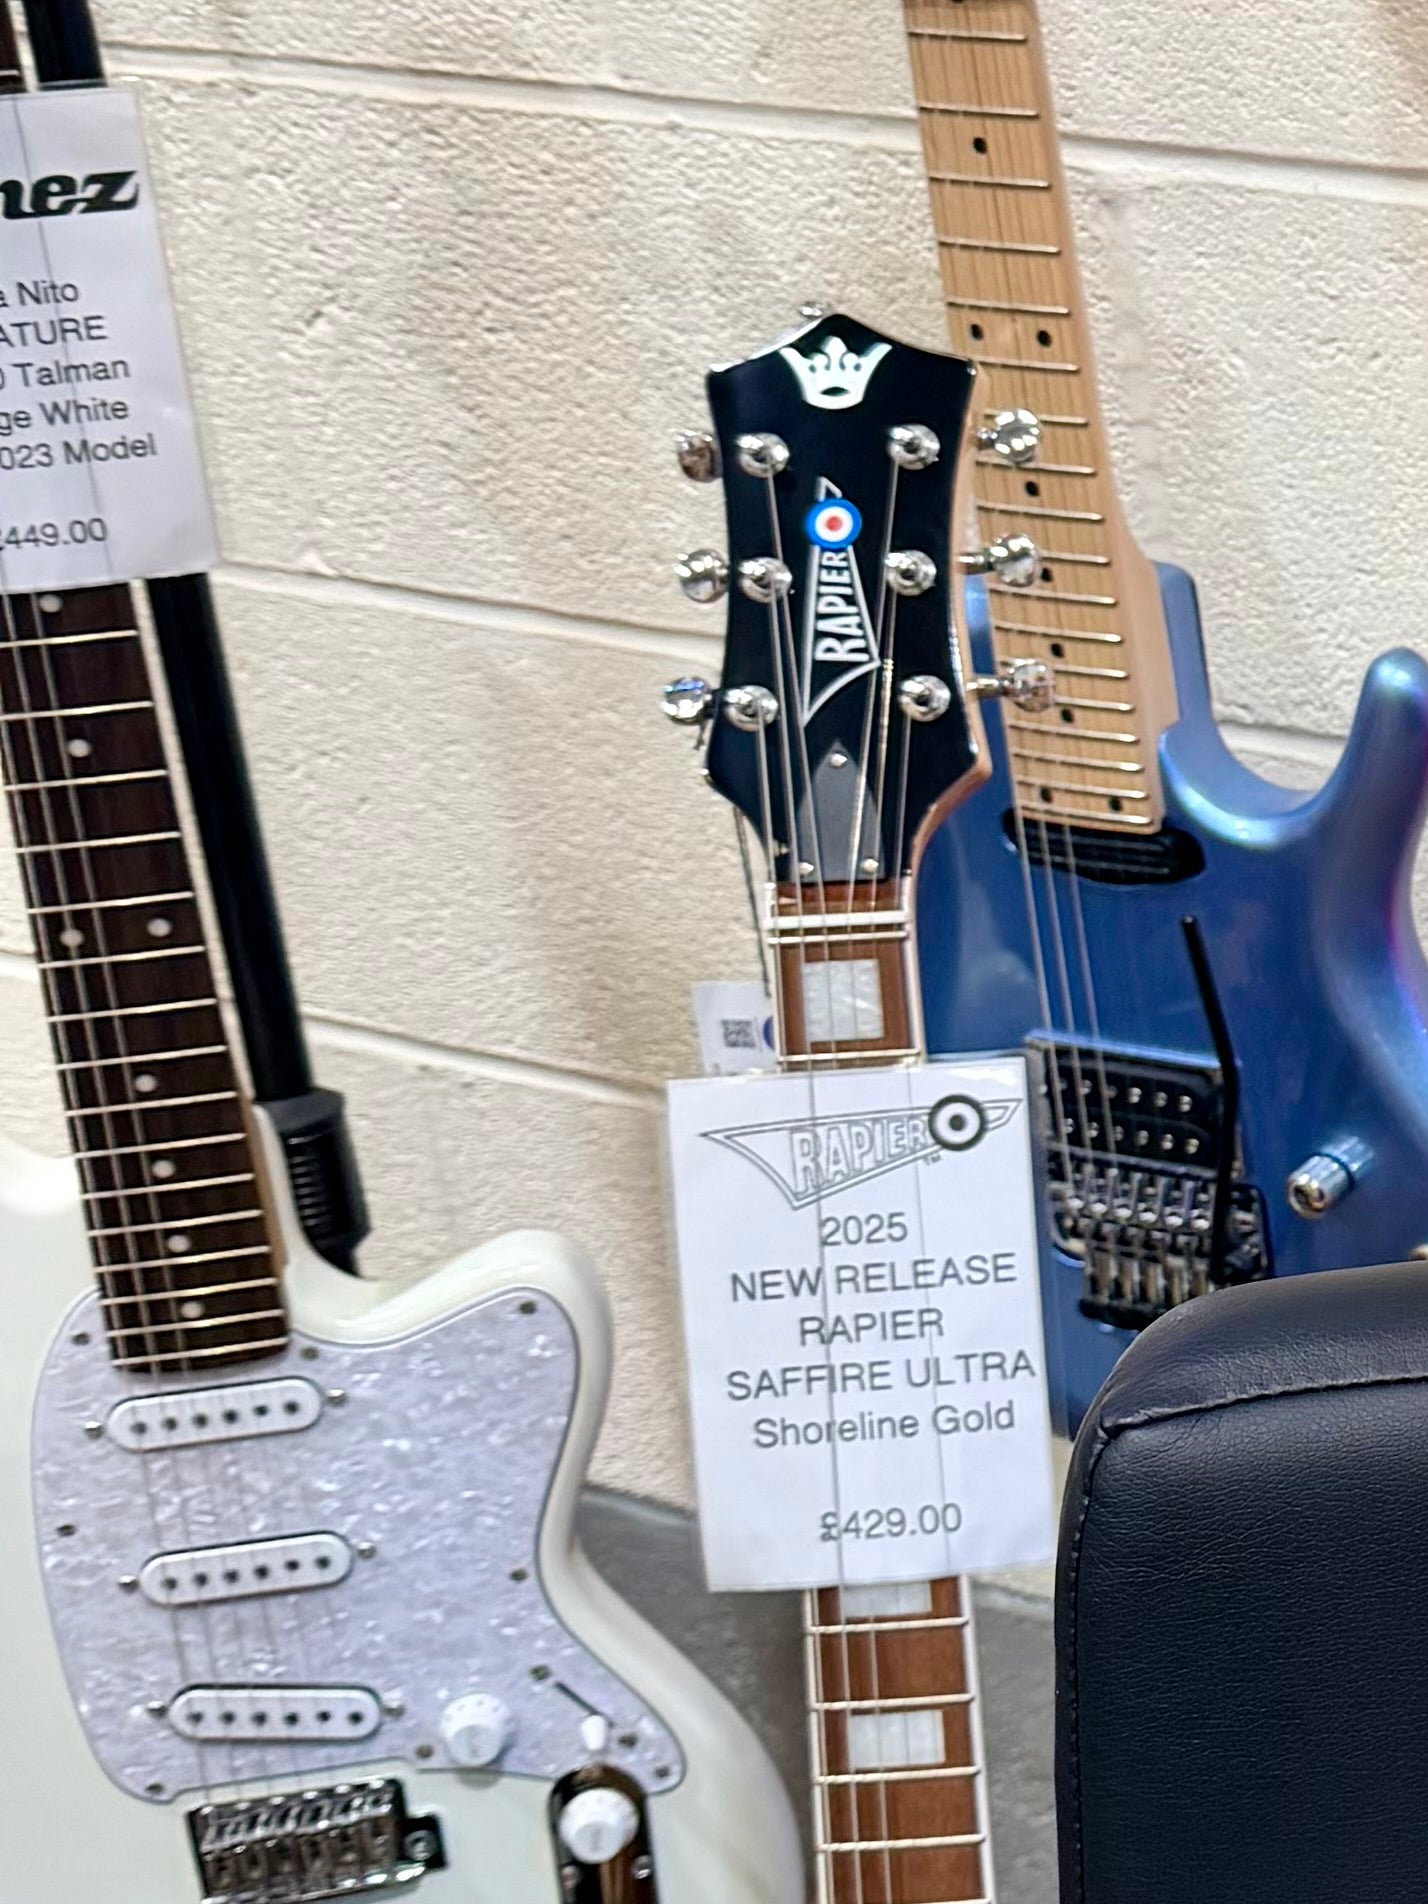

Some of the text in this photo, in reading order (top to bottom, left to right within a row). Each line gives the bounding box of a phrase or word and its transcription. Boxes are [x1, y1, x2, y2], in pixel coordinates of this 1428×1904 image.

[17, 280, 79, 306] Nito
[11, 359, 130, 387] Talman
[38, 397, 129, 426] White
[63, 432, 157, 464] Model
[0, 517, 107, 551] 449.00
[815, 551, 869, 662] RAPIER
[790, 1113, 928, 1195] RAPIER
[819, 1213, 907, 1247] 2025
[730, 1253, 1016, 1302] NEW RELEASE
[800, 1308, 944, 1345] RAPIER
[726, 1350, 1036, 1401] SAFFIRE ULTRA
[753, 1401, 1015, 1449] Shoreline Gold
[820, 1503, 962, 1543] £429.00
